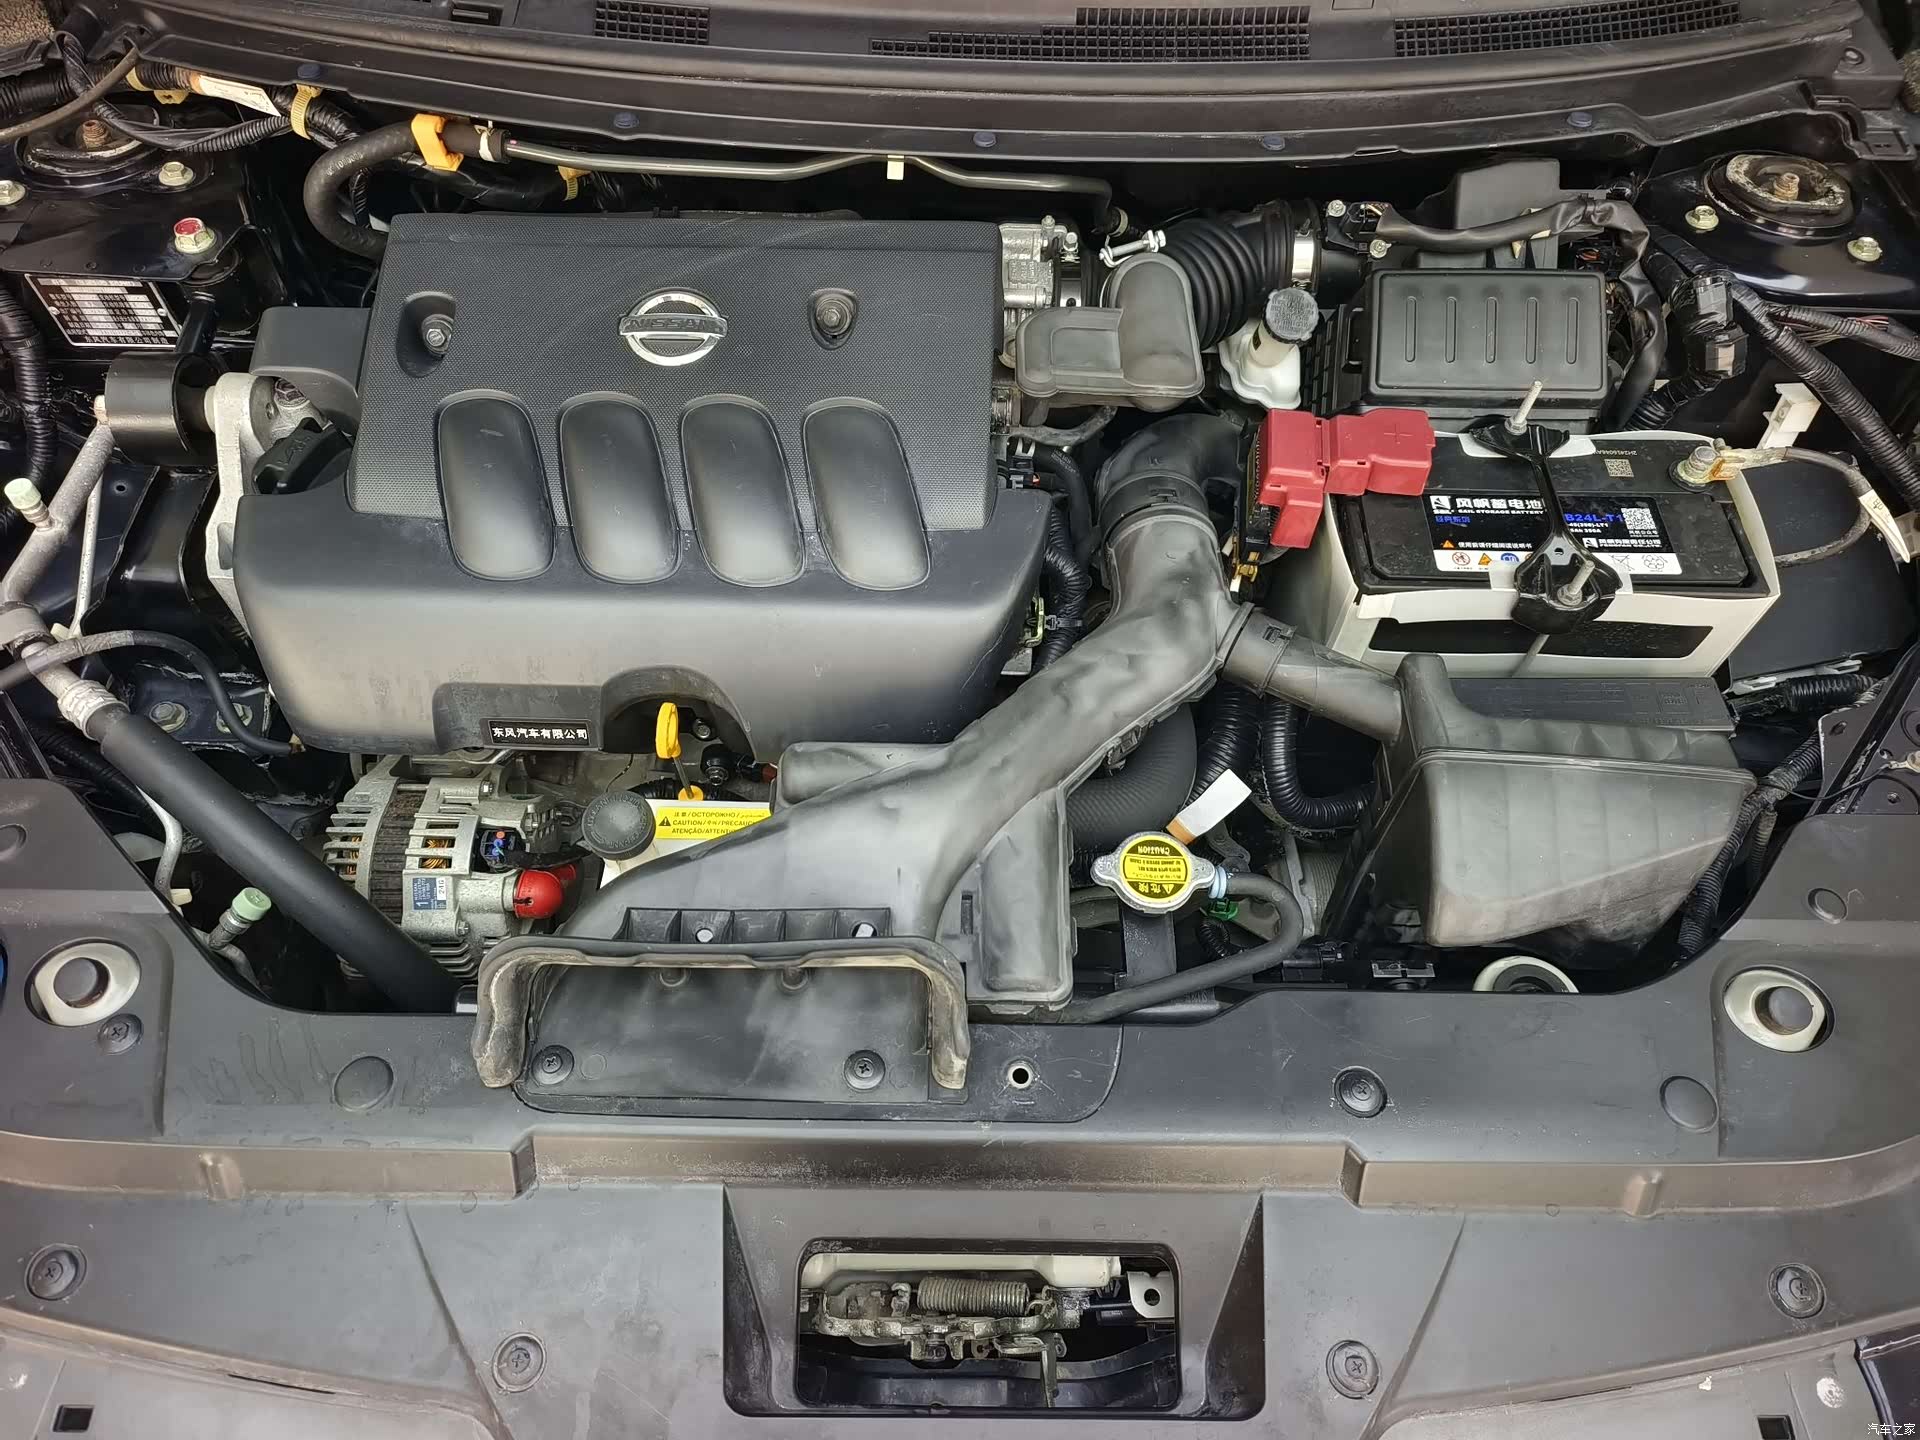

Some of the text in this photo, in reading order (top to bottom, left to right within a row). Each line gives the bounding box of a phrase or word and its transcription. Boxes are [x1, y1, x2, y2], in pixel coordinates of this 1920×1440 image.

[628, 317, 713, 331] NISSAN
[1456, 497, 1543, 510] 风帆蓄电池
[492, 727, 588, 740] 东风汽车有限公司
[1137, 845, 1170, 856] CAUTION
